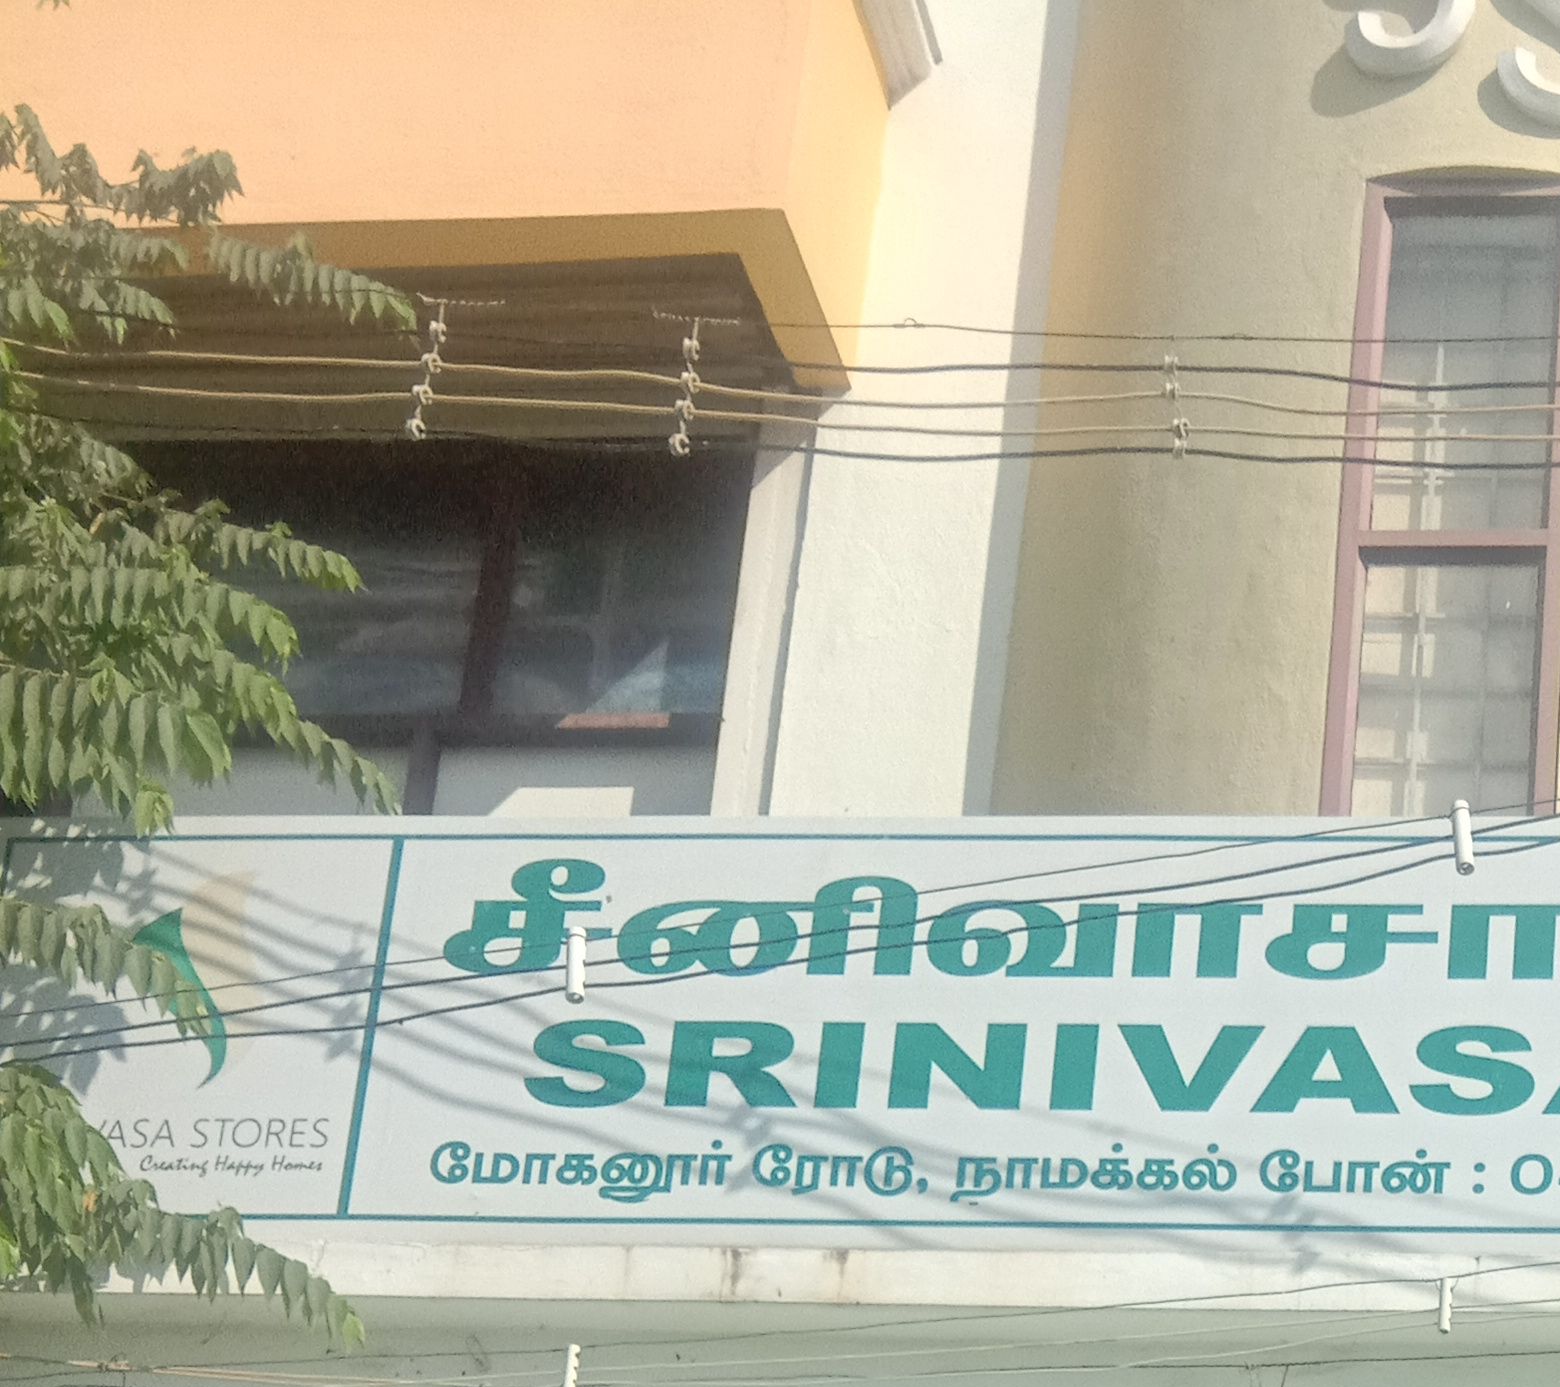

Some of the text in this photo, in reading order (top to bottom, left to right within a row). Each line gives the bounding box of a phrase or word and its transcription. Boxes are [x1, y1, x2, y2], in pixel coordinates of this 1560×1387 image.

[190, 1118, 331, 1149] STORES
[139, 1154, 323, 1178] Creating Happy Homes
[431, 1140, 733, 1203] மோகனூர்
[752, 1143, 930, 1198] ரோடு,
[950, 1143, 1239, 1203] நாமக்கல்
[1260, 1148, 1452, 1196] போன்
